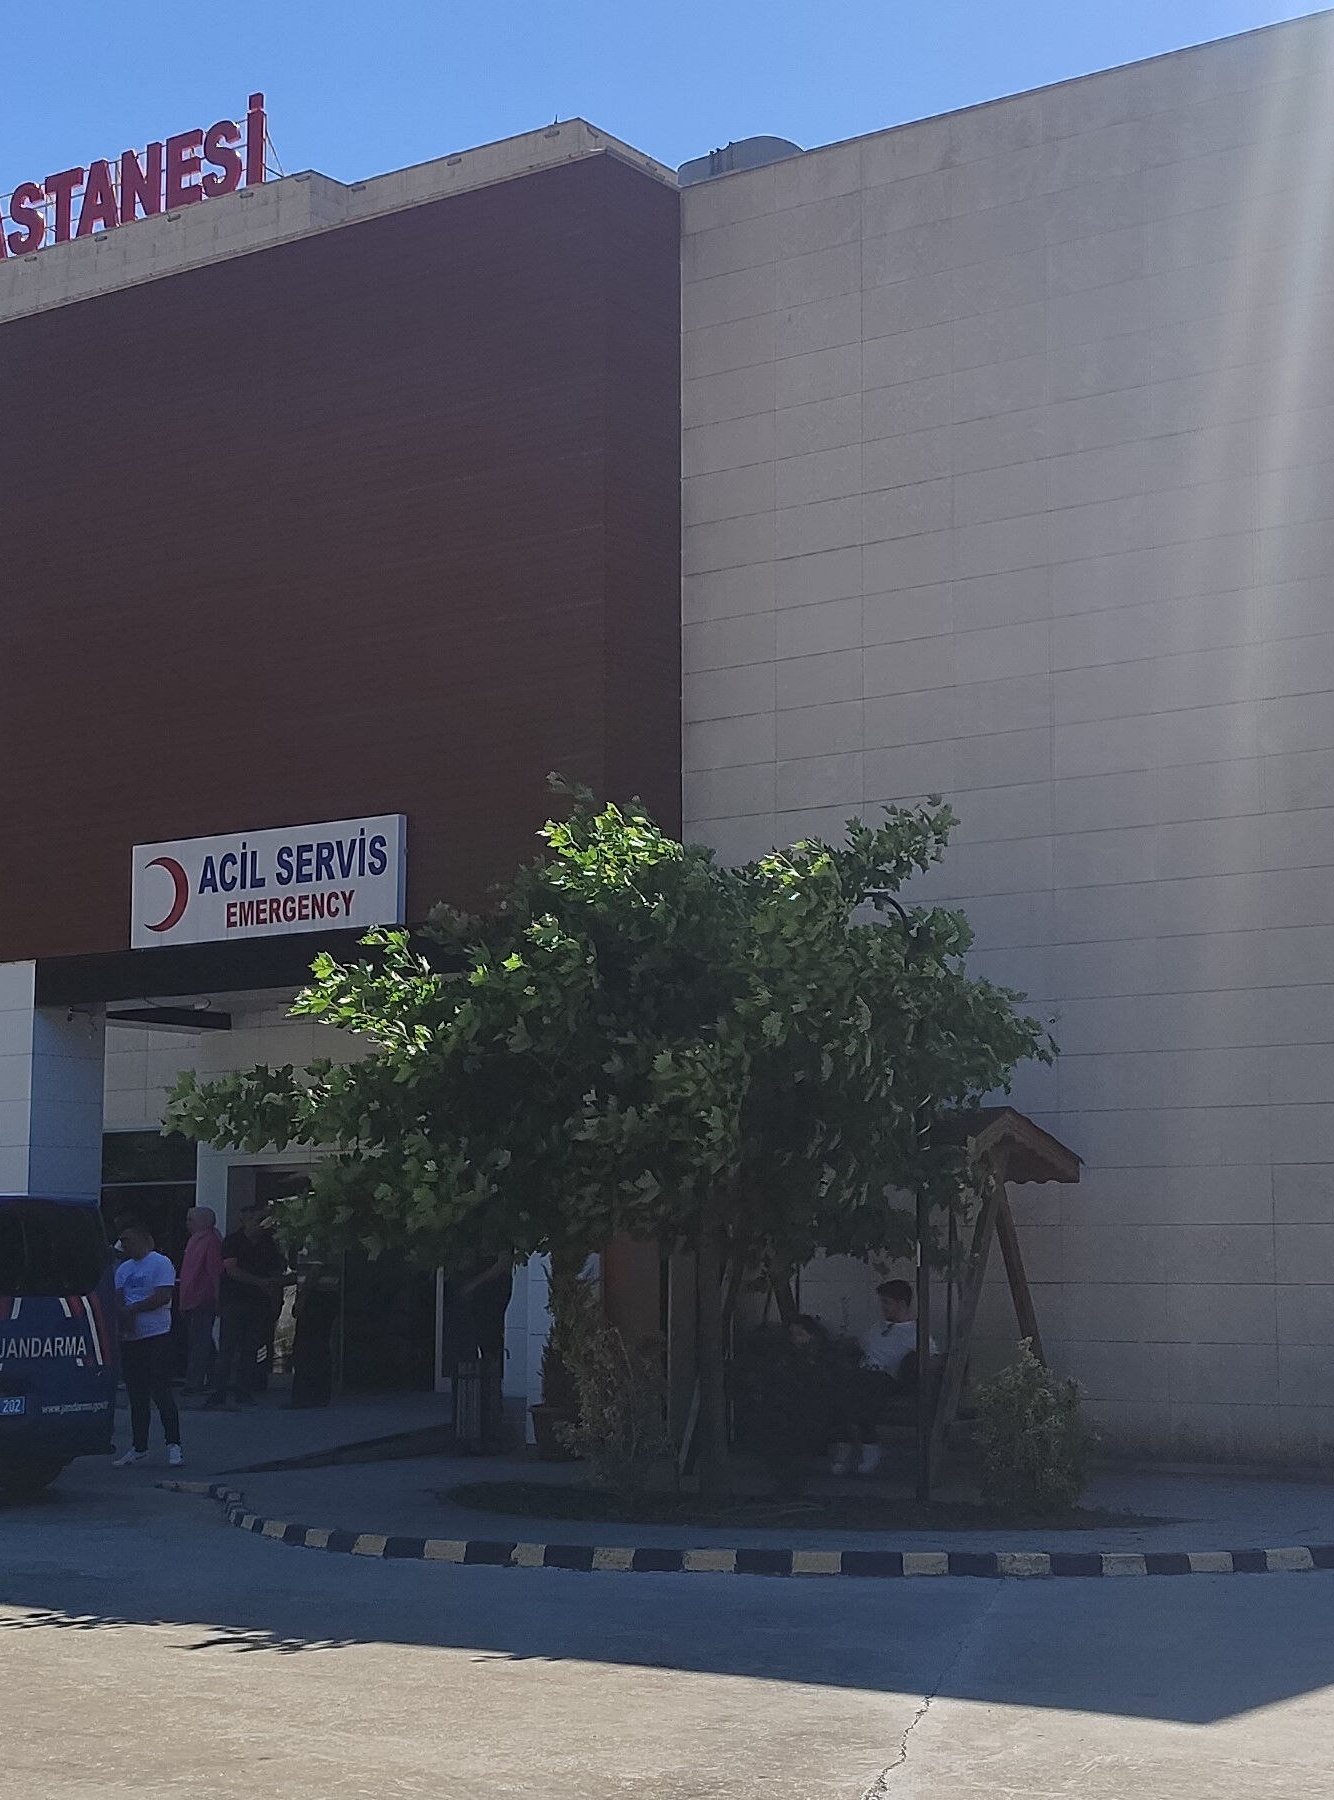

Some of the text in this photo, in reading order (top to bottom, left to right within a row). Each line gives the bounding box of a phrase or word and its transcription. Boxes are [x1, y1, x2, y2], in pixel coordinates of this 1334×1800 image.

[198, 828, 387, 894] ACİL SERVİS
[226, 889, 355, 928] EMERGENCY
[3, 1400, 21, 1414] 202
